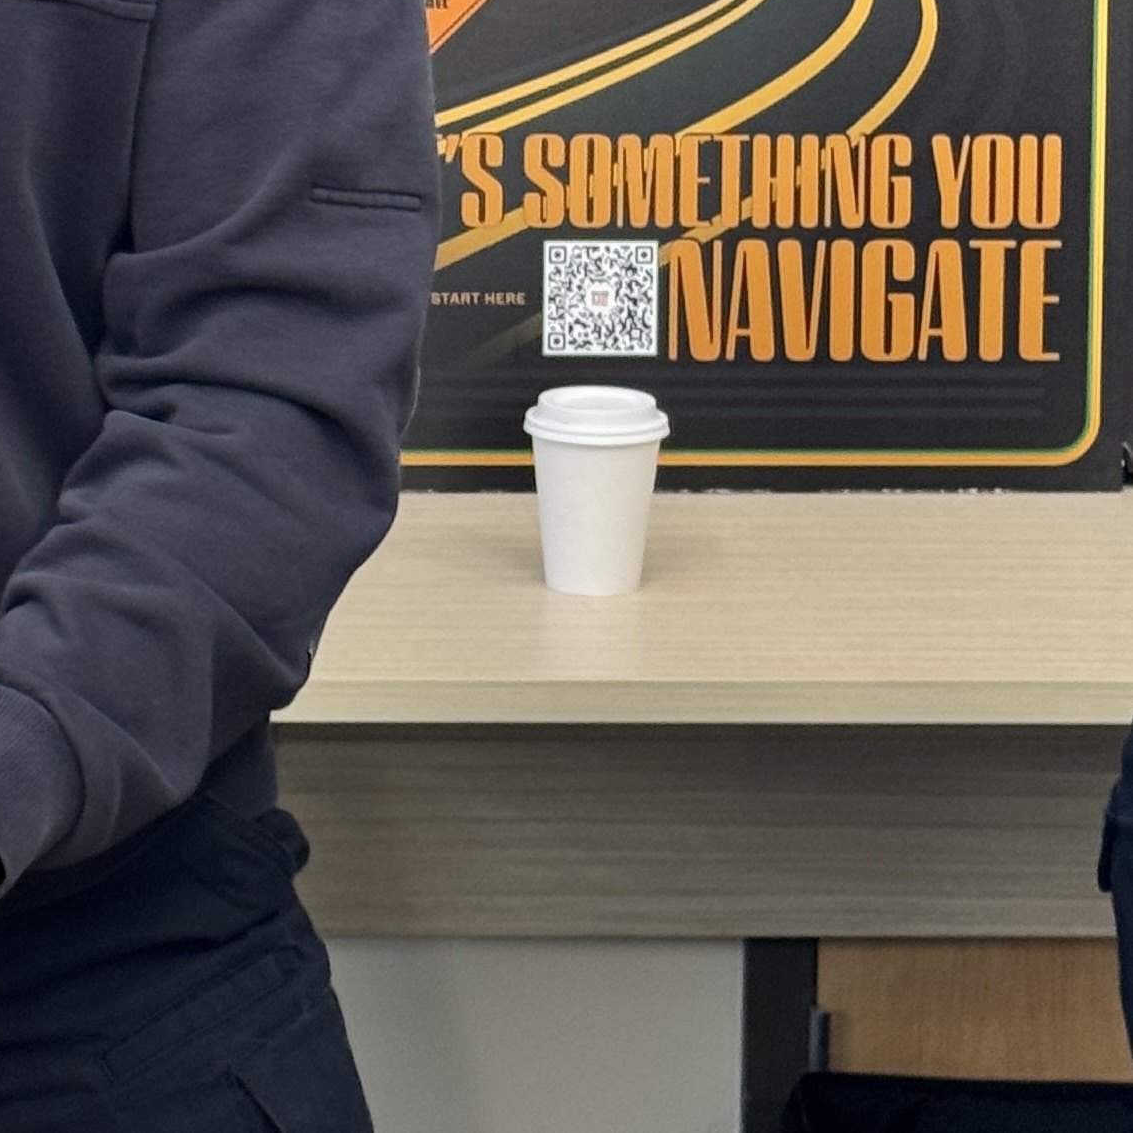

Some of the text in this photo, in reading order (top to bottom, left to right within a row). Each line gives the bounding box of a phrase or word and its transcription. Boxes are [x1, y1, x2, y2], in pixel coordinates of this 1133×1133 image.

[430, 133, 1063, 229] 'S SOMETHING YOU
[430, 291, 526, 306] START HERE
[668, 238, 1063, 362] NAVIGATE
